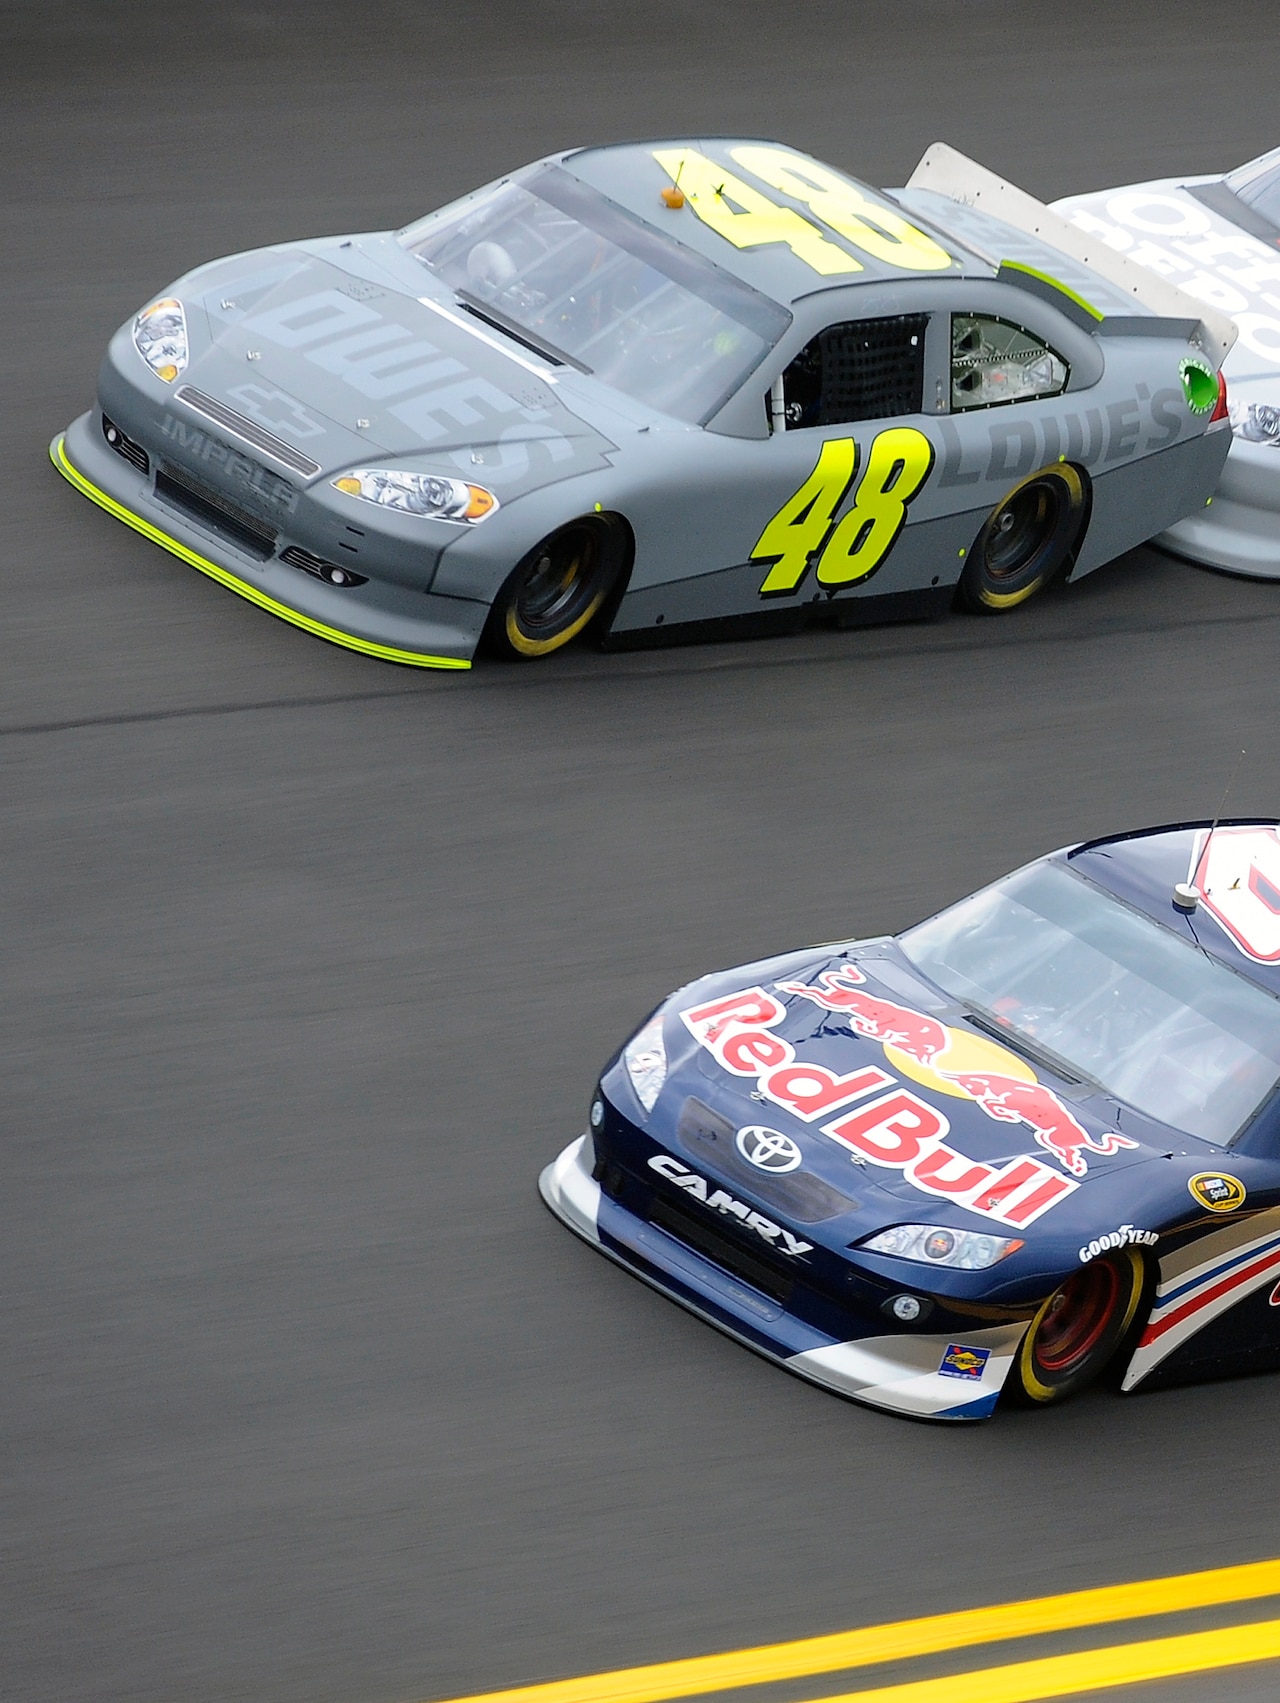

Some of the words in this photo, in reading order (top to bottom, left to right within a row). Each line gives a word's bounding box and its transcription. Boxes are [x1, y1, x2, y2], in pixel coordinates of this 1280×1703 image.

[652, 146, 952, 276] 48
[937, 383, 1184, 488] LOWE'S
[749, 427, 934, 598] 48
[680, 987, 896, 1121] Red
[821, 1089, 1080, 1229] Bull
[647, 1154, 814, 1257] CAMRY
[1079, 1225, 1159, 1263] GOODYEAR
